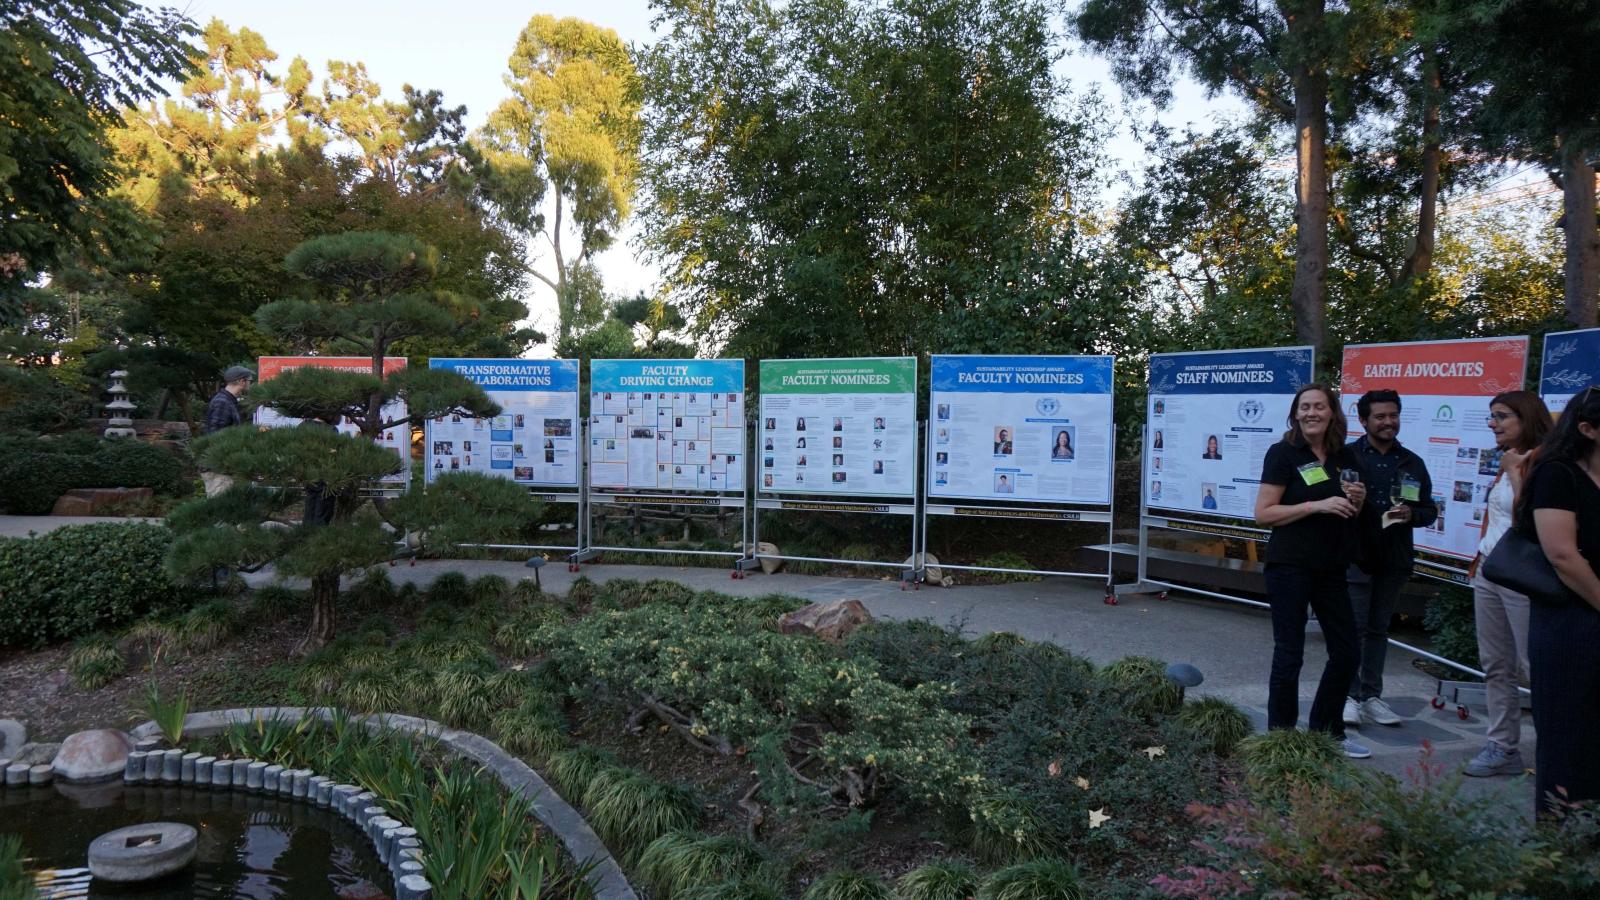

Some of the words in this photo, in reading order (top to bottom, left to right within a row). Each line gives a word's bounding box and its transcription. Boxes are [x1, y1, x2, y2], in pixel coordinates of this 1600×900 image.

[454, 366, 550, 375] TRANSFORMATIVE
[642, 366, 688, 376] FACULTY
[1364, 364, 1402, 378] EARTH
[1404, 362, 1484, 377] ADVOCATES
[620, 376, 664, 386] DRIVING
[668, 376, 714, 386] CHANGE
[782, 375, 828, 385] FACULTY
[831, 374, 890, 385] NOMINEES
[958, 373, 1012, 383] FACULTY
[1015, 373, 1083, 384] NOMINEES
[1176, 373, 1209, 384] STAFF
[1210, 371, 1274, 384] NOMINEES
